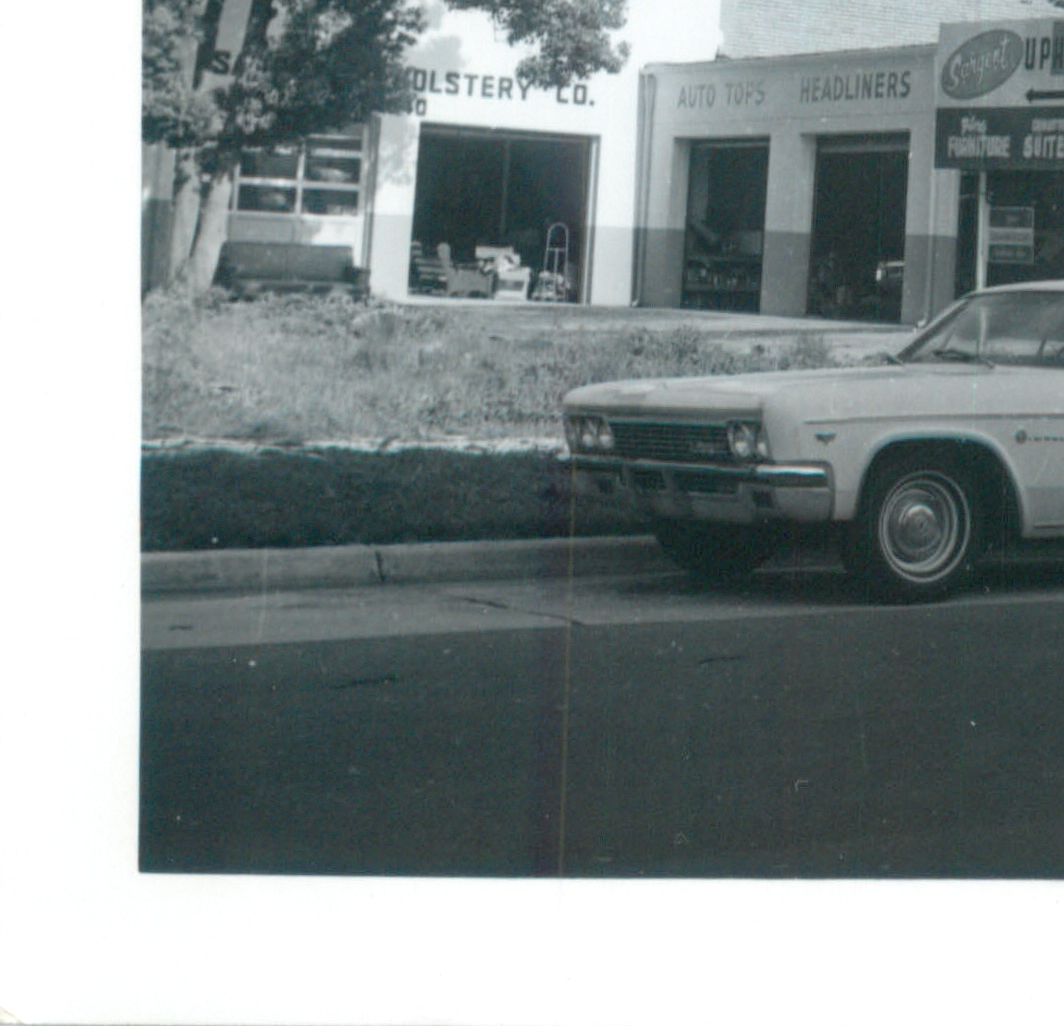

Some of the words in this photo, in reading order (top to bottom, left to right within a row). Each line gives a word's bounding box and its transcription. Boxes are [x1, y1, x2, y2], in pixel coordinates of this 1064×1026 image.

[413, 68, 531, 101] OLSTERY
[677, 84, 716, 110] AUTO
[801, 70, 911, 104] HEADLINERS
